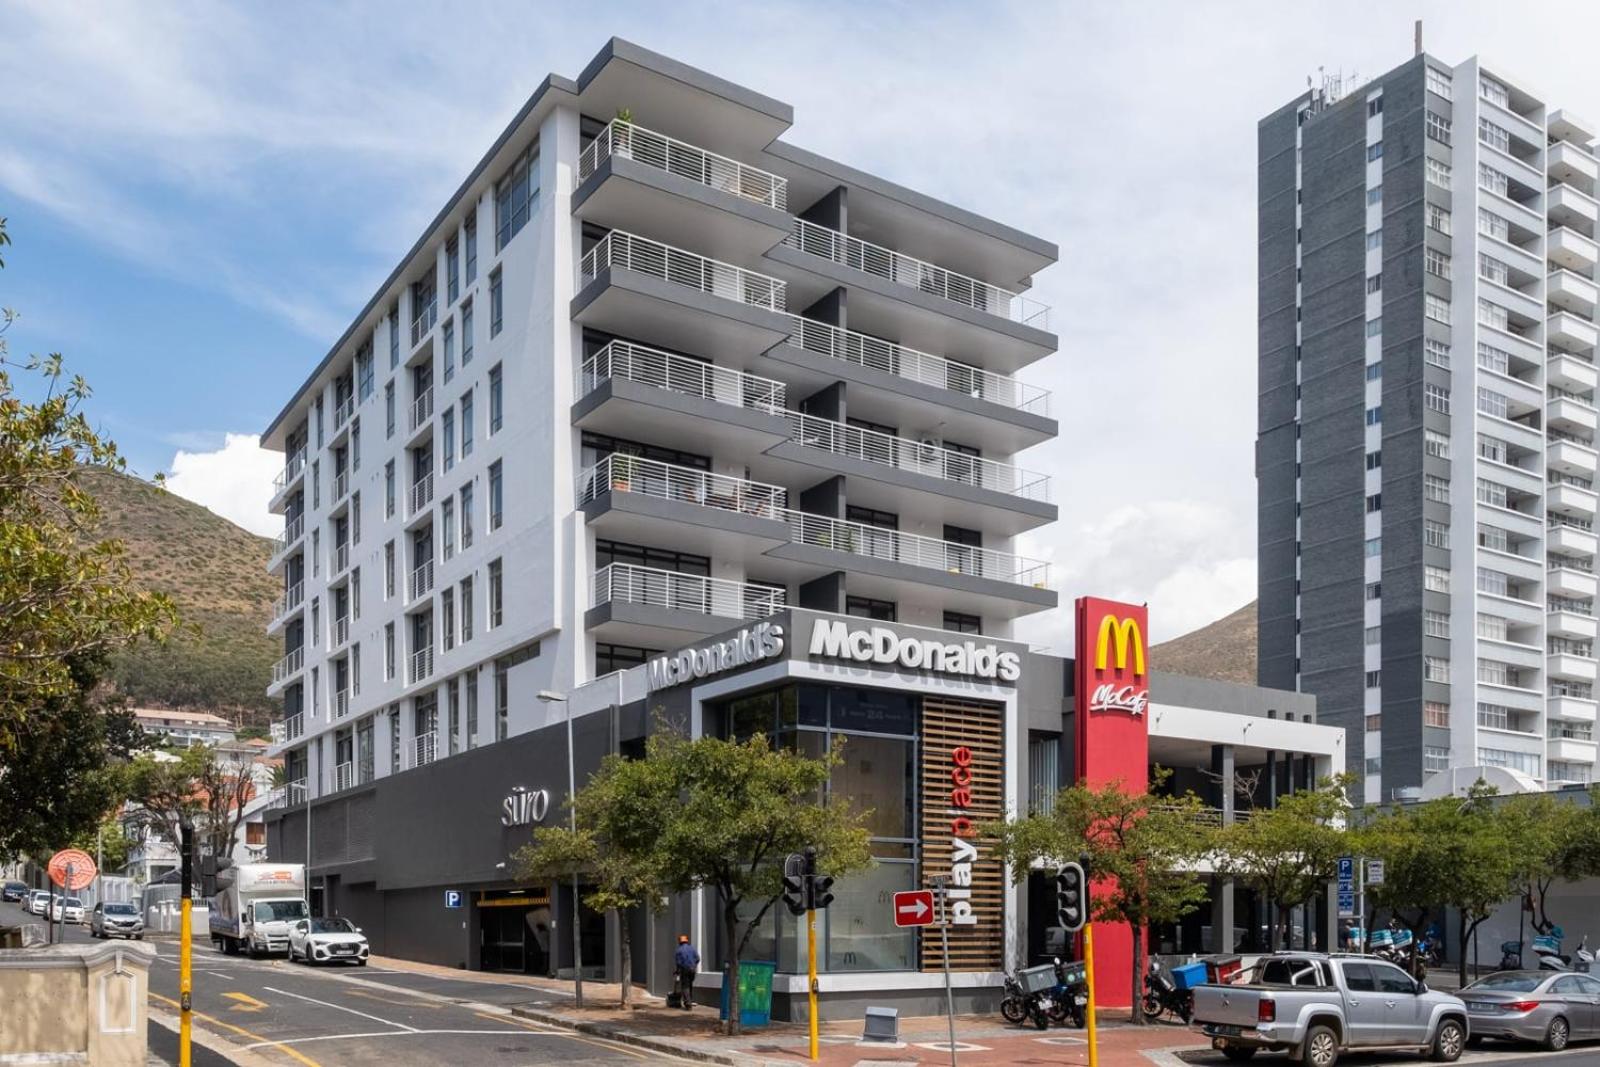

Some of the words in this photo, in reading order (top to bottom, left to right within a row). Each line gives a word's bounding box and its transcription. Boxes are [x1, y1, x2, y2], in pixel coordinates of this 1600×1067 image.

[647, 621, 784, 691] McDonald's
[809, 619, 1021, 681] McDonald's
[948, 746, 977, 924] playplace
[1341, 860, 1350, 870] P
[449, 893, 459, 905] P
